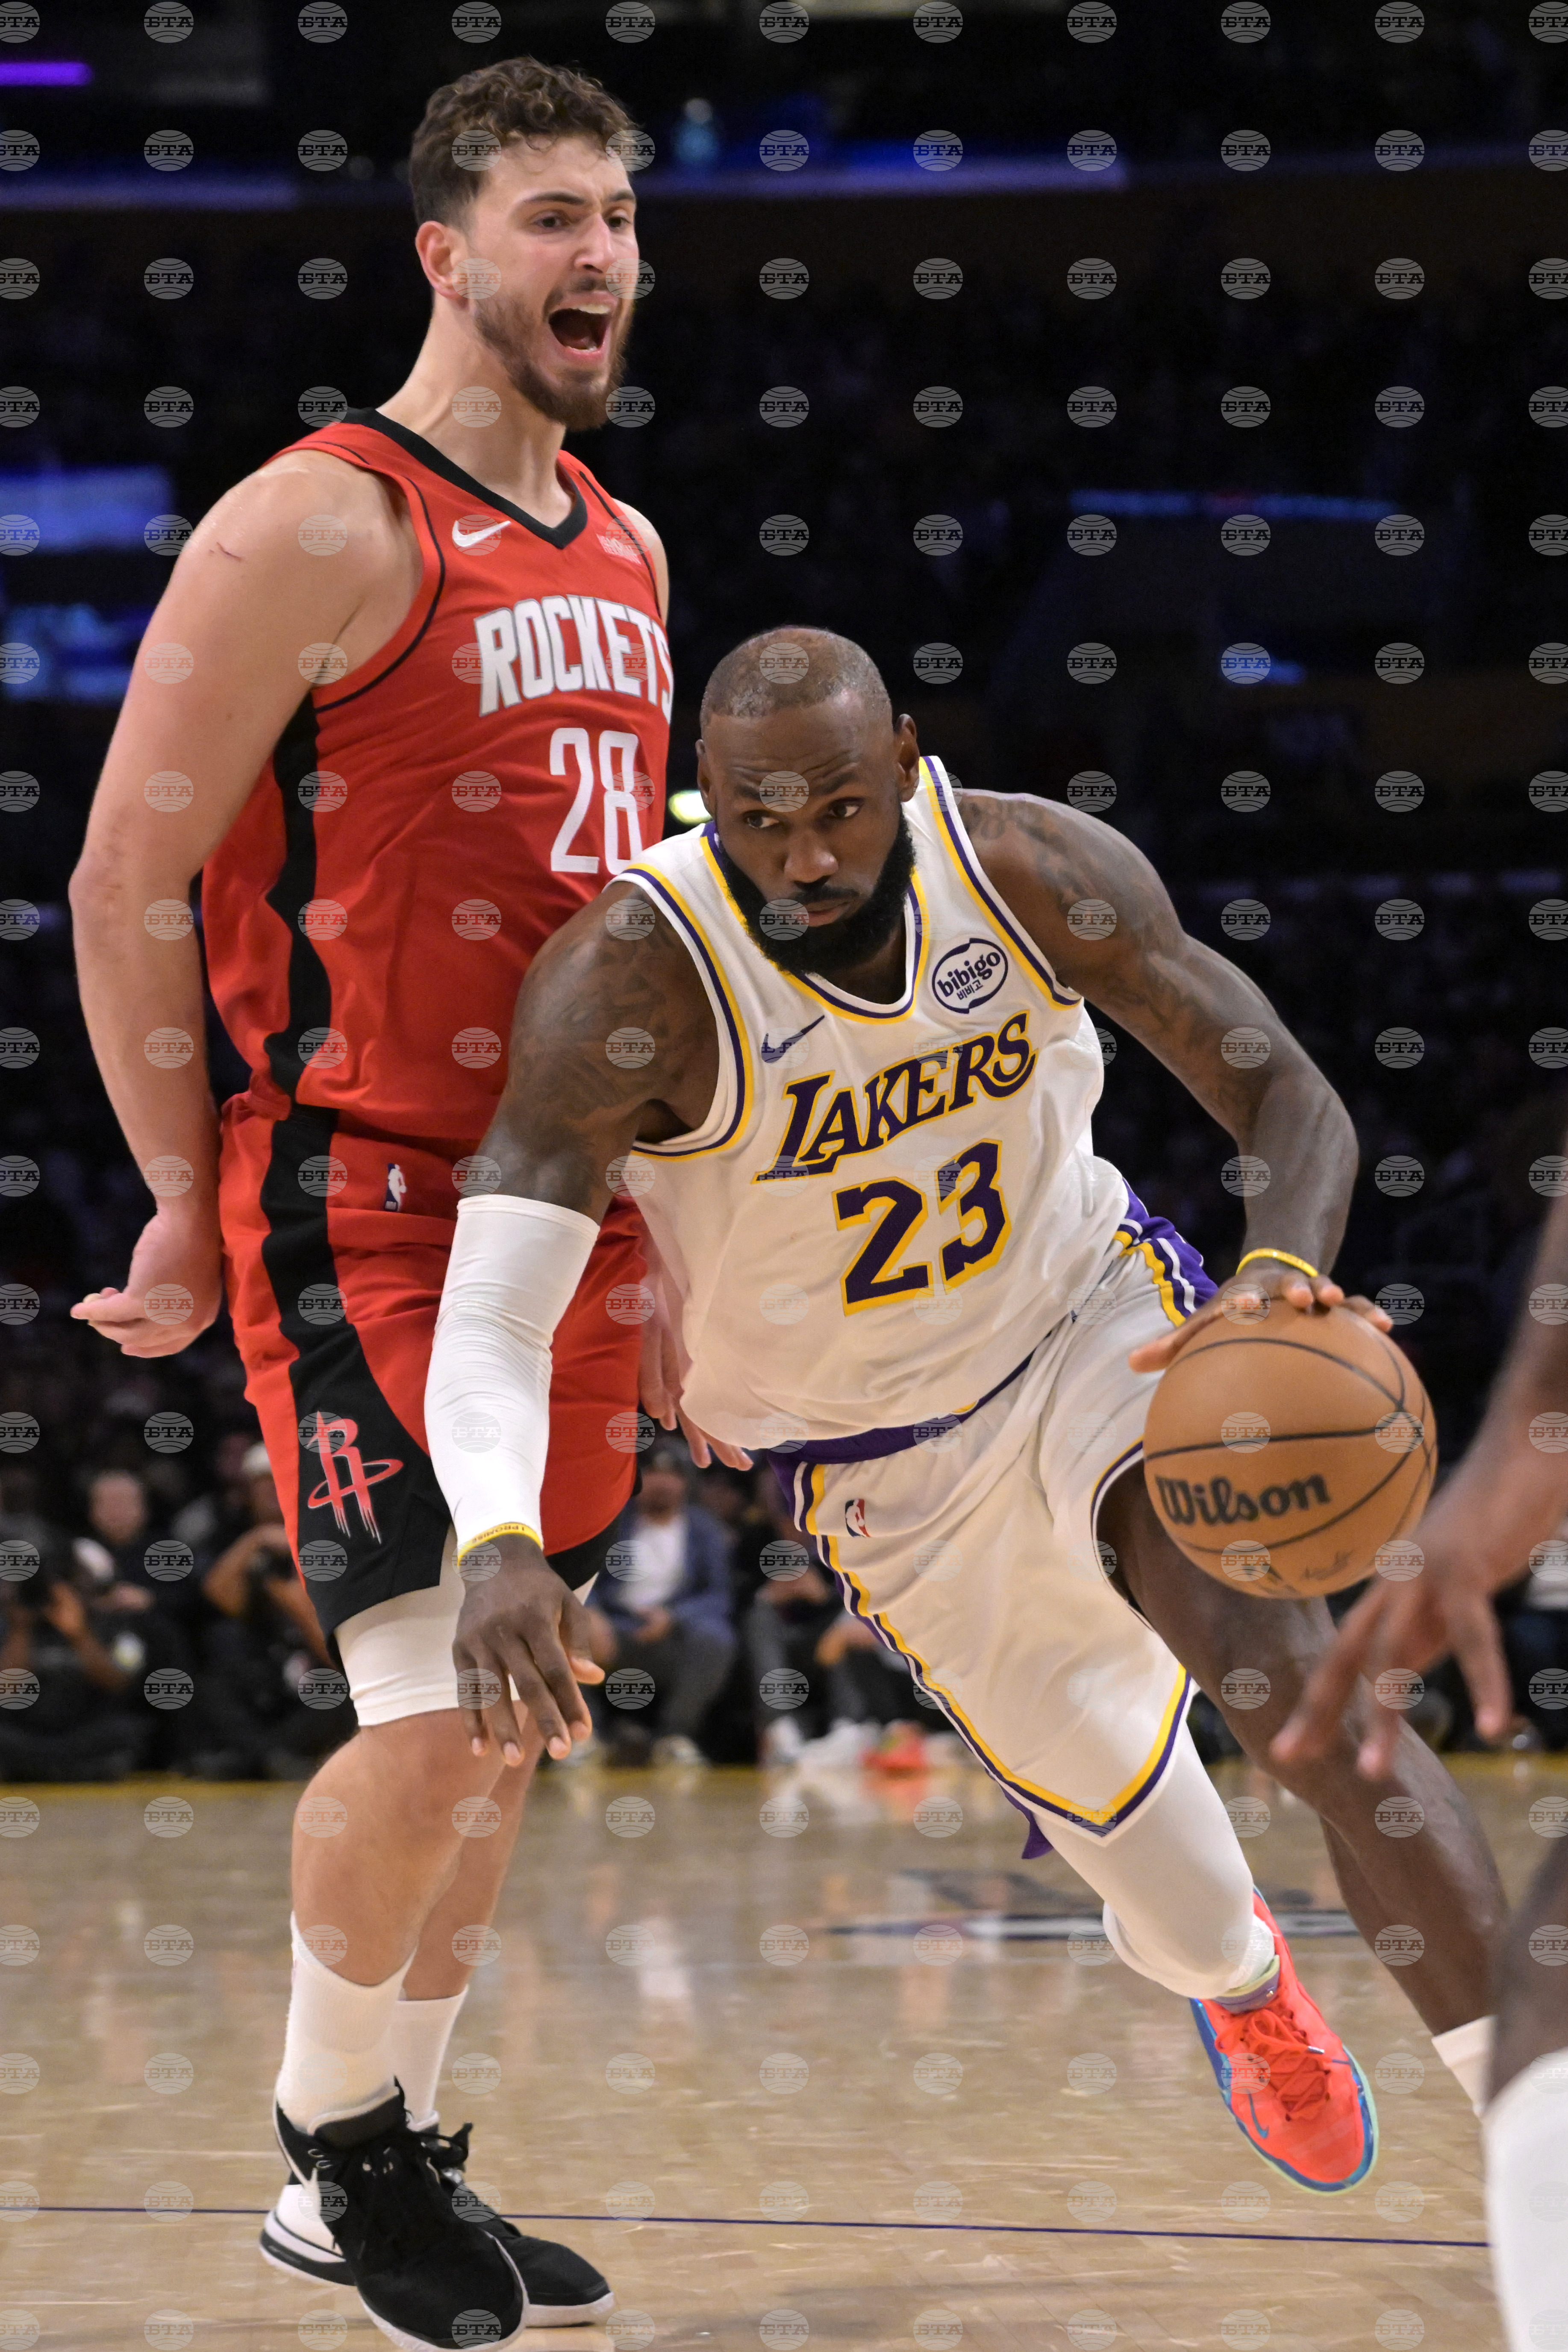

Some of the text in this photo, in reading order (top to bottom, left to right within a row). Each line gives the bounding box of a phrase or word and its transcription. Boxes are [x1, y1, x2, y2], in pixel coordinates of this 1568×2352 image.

[549, 727, 643, 876] 28
[937, 952, 1000, 997] bibigo
[956, 979, 984, 1000] 비비고
[751, 1009, 1038, 1184] LAKERS
[831, 1138, 1012, 1317] 23
[1154, 1474, 1330, 1526] Wilson
